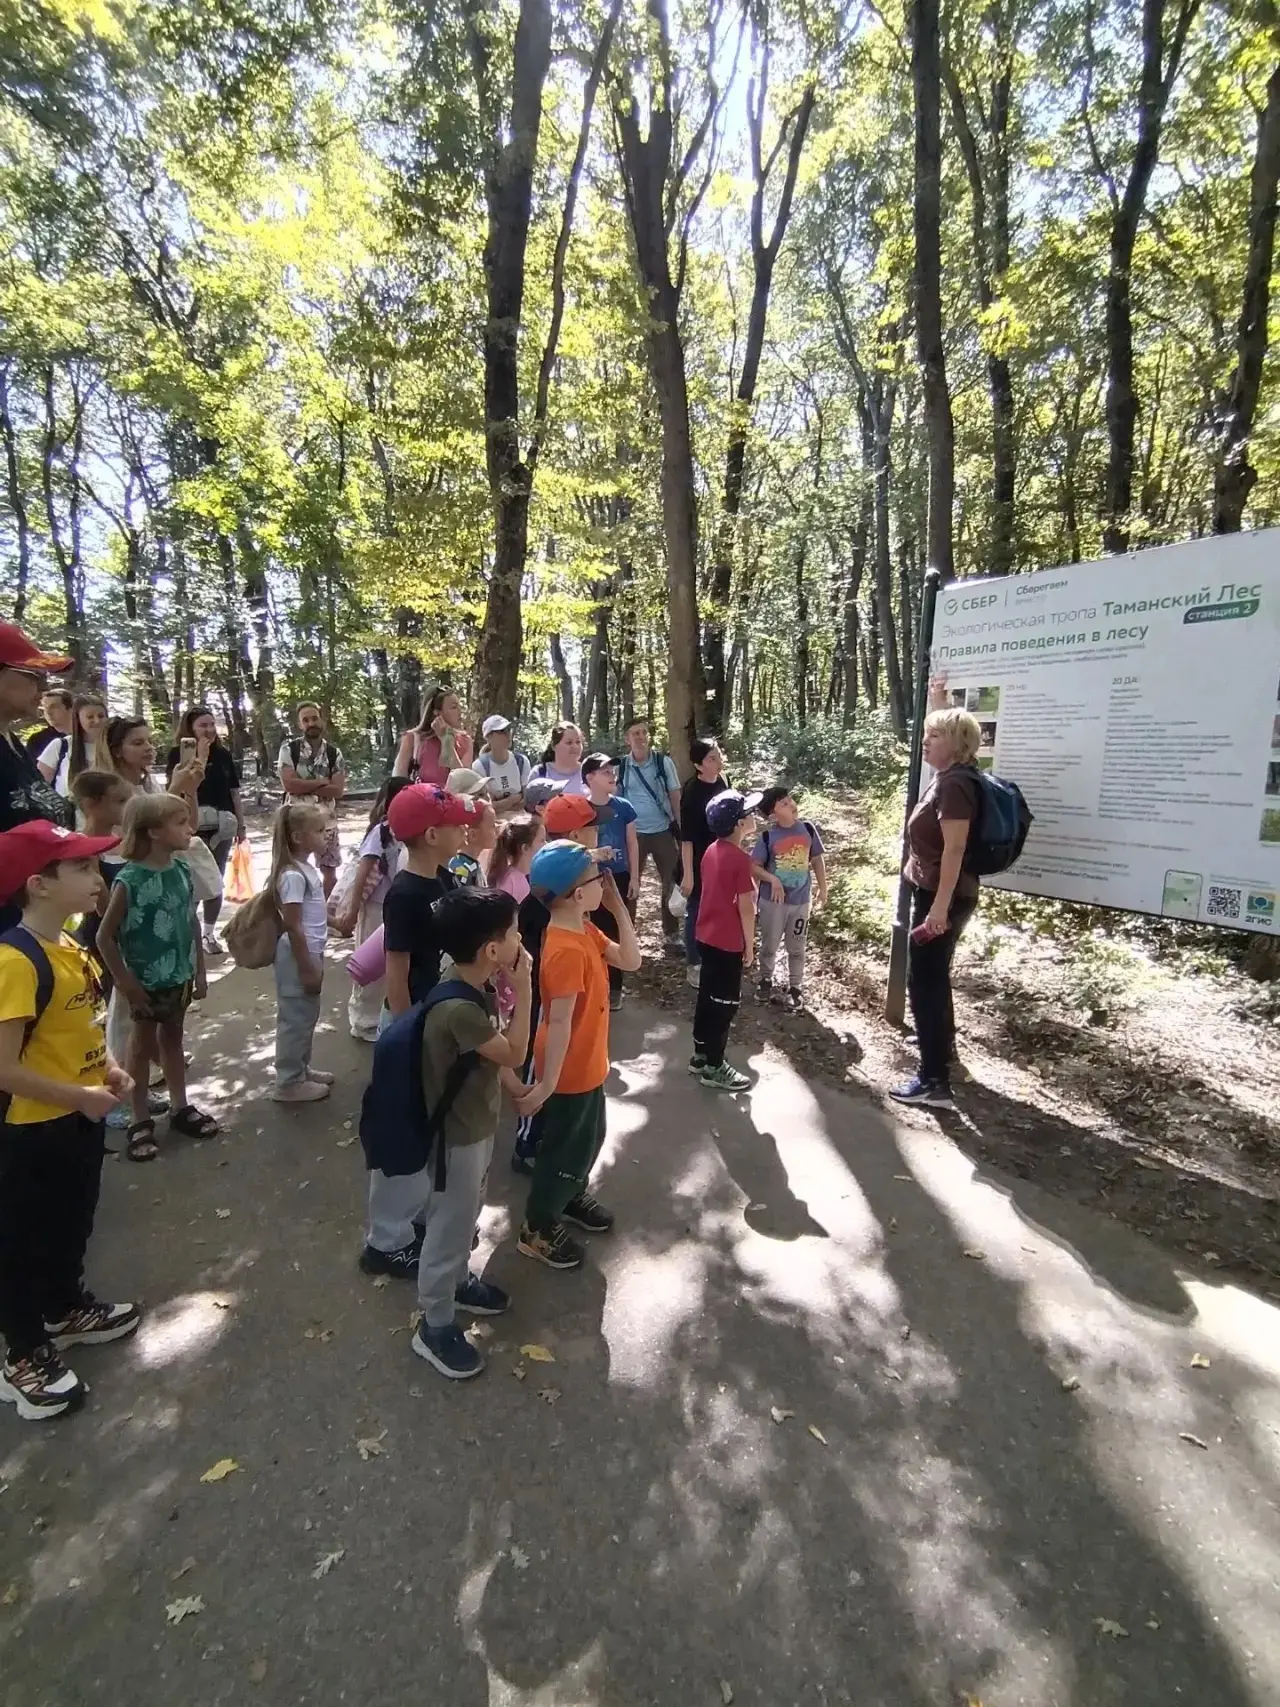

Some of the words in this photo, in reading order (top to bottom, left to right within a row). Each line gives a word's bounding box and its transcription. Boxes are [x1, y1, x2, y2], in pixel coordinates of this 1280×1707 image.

[1015, 579, 1068, 596] Сберегаем
[941, 614, 1046, 639] Экологическая
[1051, 607, 1098, 626] тропа
[1102, 586, 1211, 617] Таманский
[1216, 583, 1262, 602] Лес
[961, 594, 998, 611] СБЕР
[1187, 606, 1240, 621] станция
[1243, 603, 1252, 614] 2
[939, 644, 997, 660] Правила
[1001, 632, 1086, 653] поведения
[1091, 631, 1101, 642] в
[1106, 625, 1150, 641] лесу
[1245, 915, 1273, 926] 2ГИС
